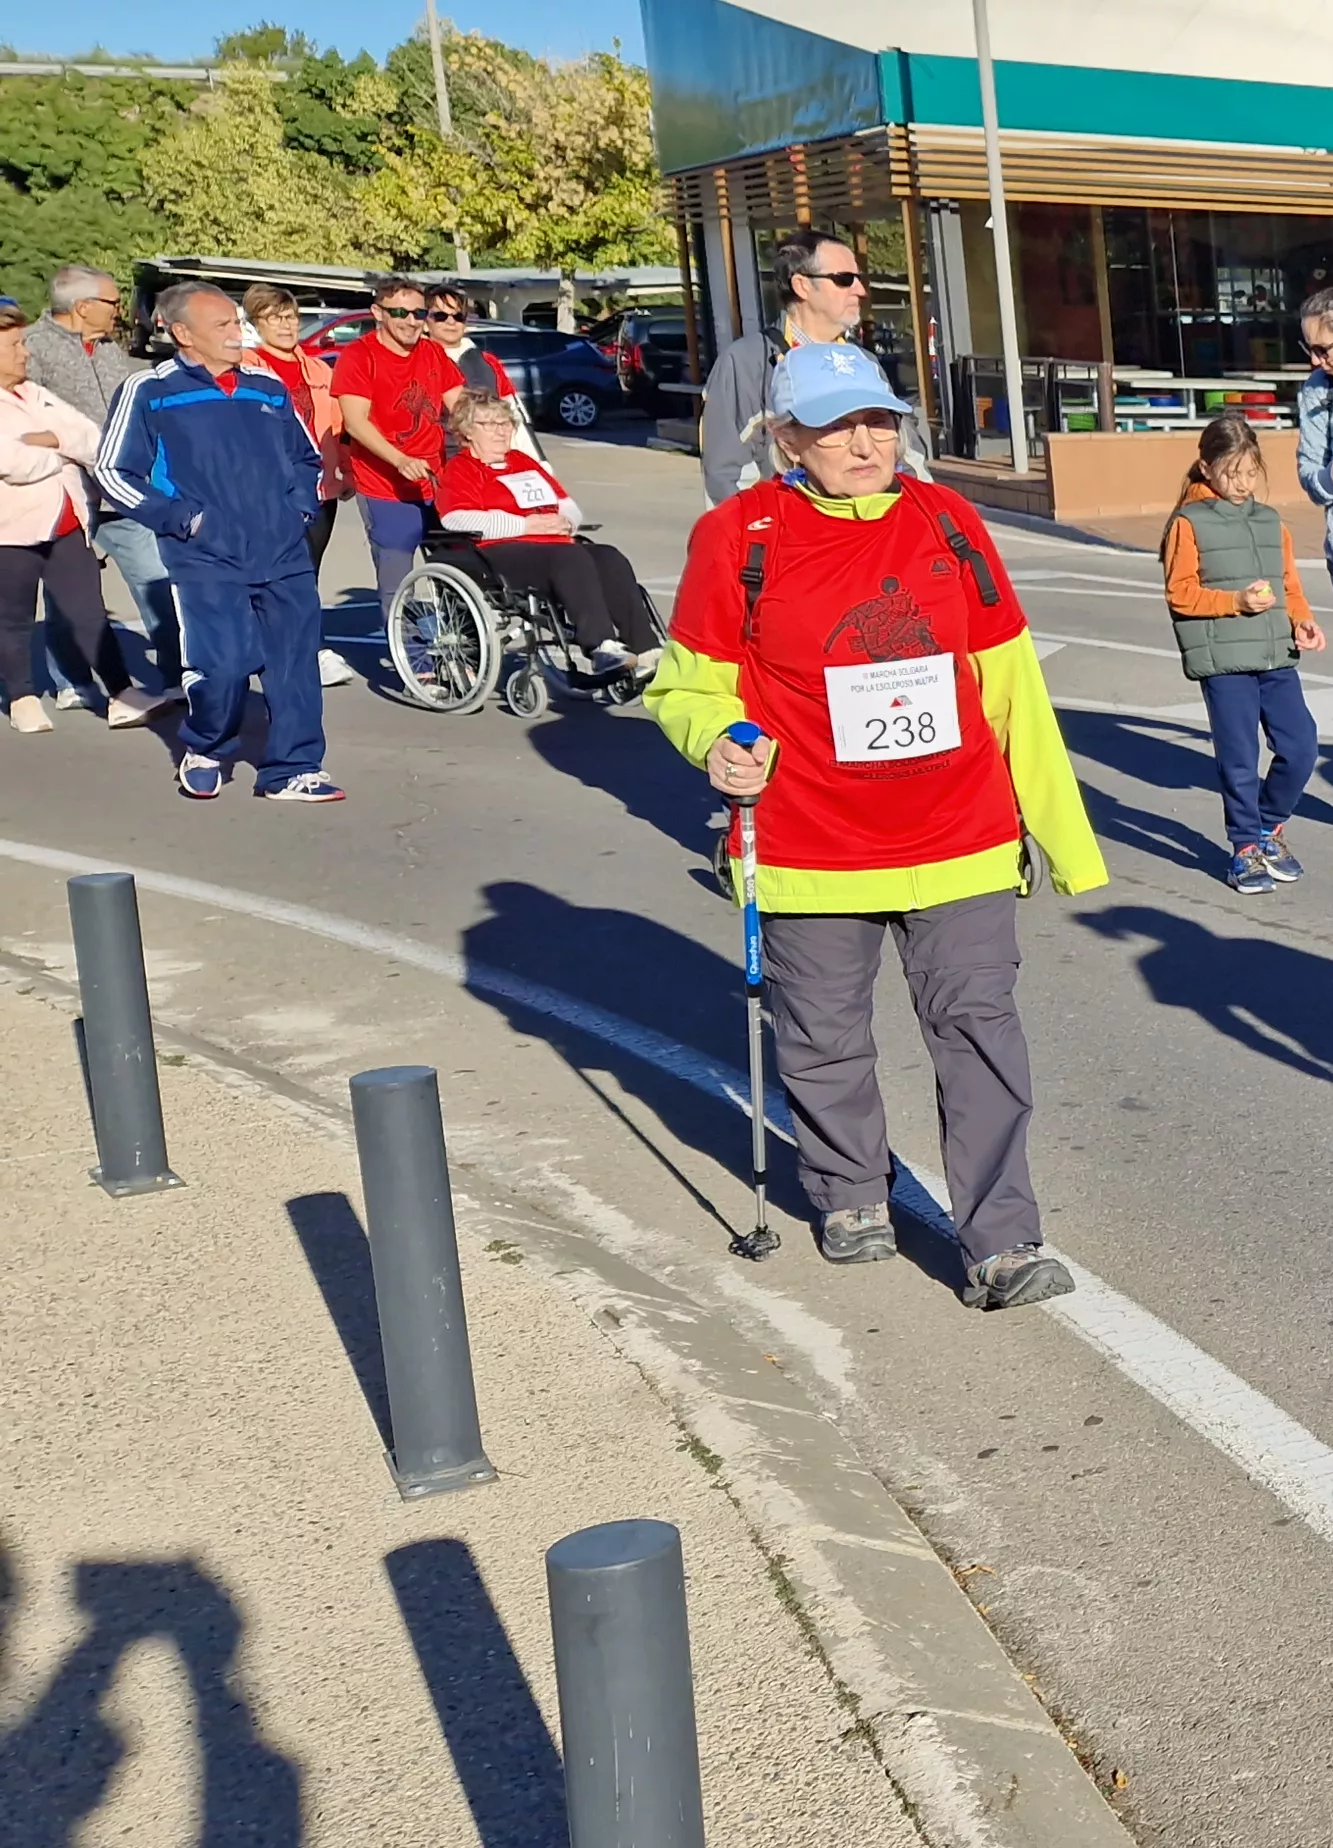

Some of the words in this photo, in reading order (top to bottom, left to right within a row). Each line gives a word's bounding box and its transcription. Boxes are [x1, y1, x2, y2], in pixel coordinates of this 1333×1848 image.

[865, 711, 936, 750] 238
[746, 878, 755, 899] 500
[749, 935, 759, 975] Quechua
